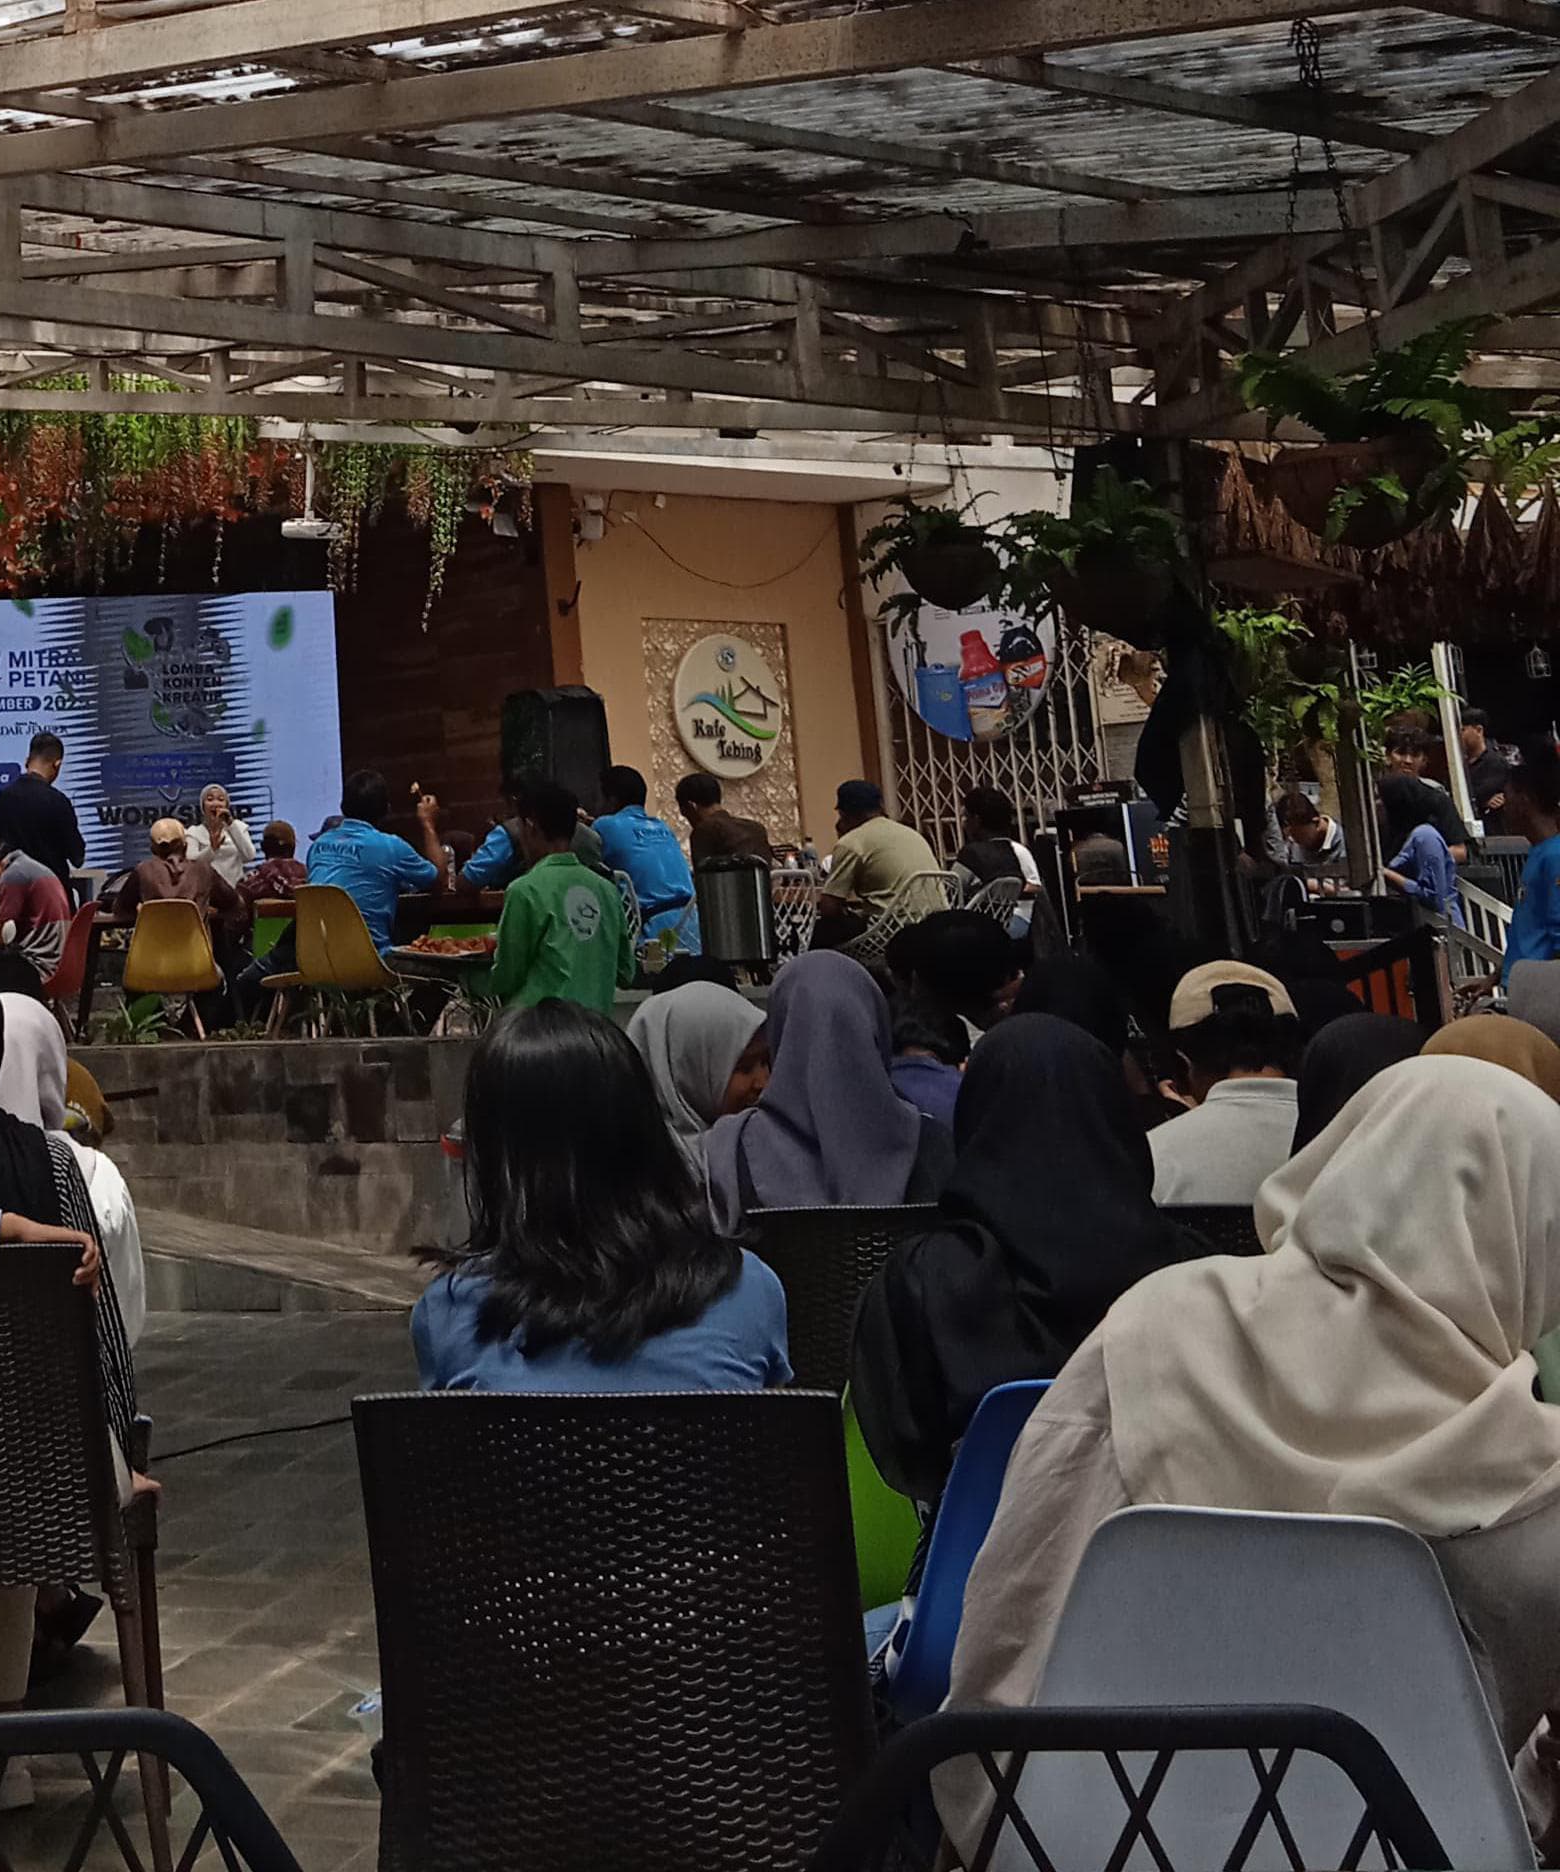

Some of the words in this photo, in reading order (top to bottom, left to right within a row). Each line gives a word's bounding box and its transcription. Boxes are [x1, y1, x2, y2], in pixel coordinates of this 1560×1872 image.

[8, 650, 81, 668] MITRA
[162, 663, 215, 675] LOMBA
[162, 677, 223, 688] KONTEN
